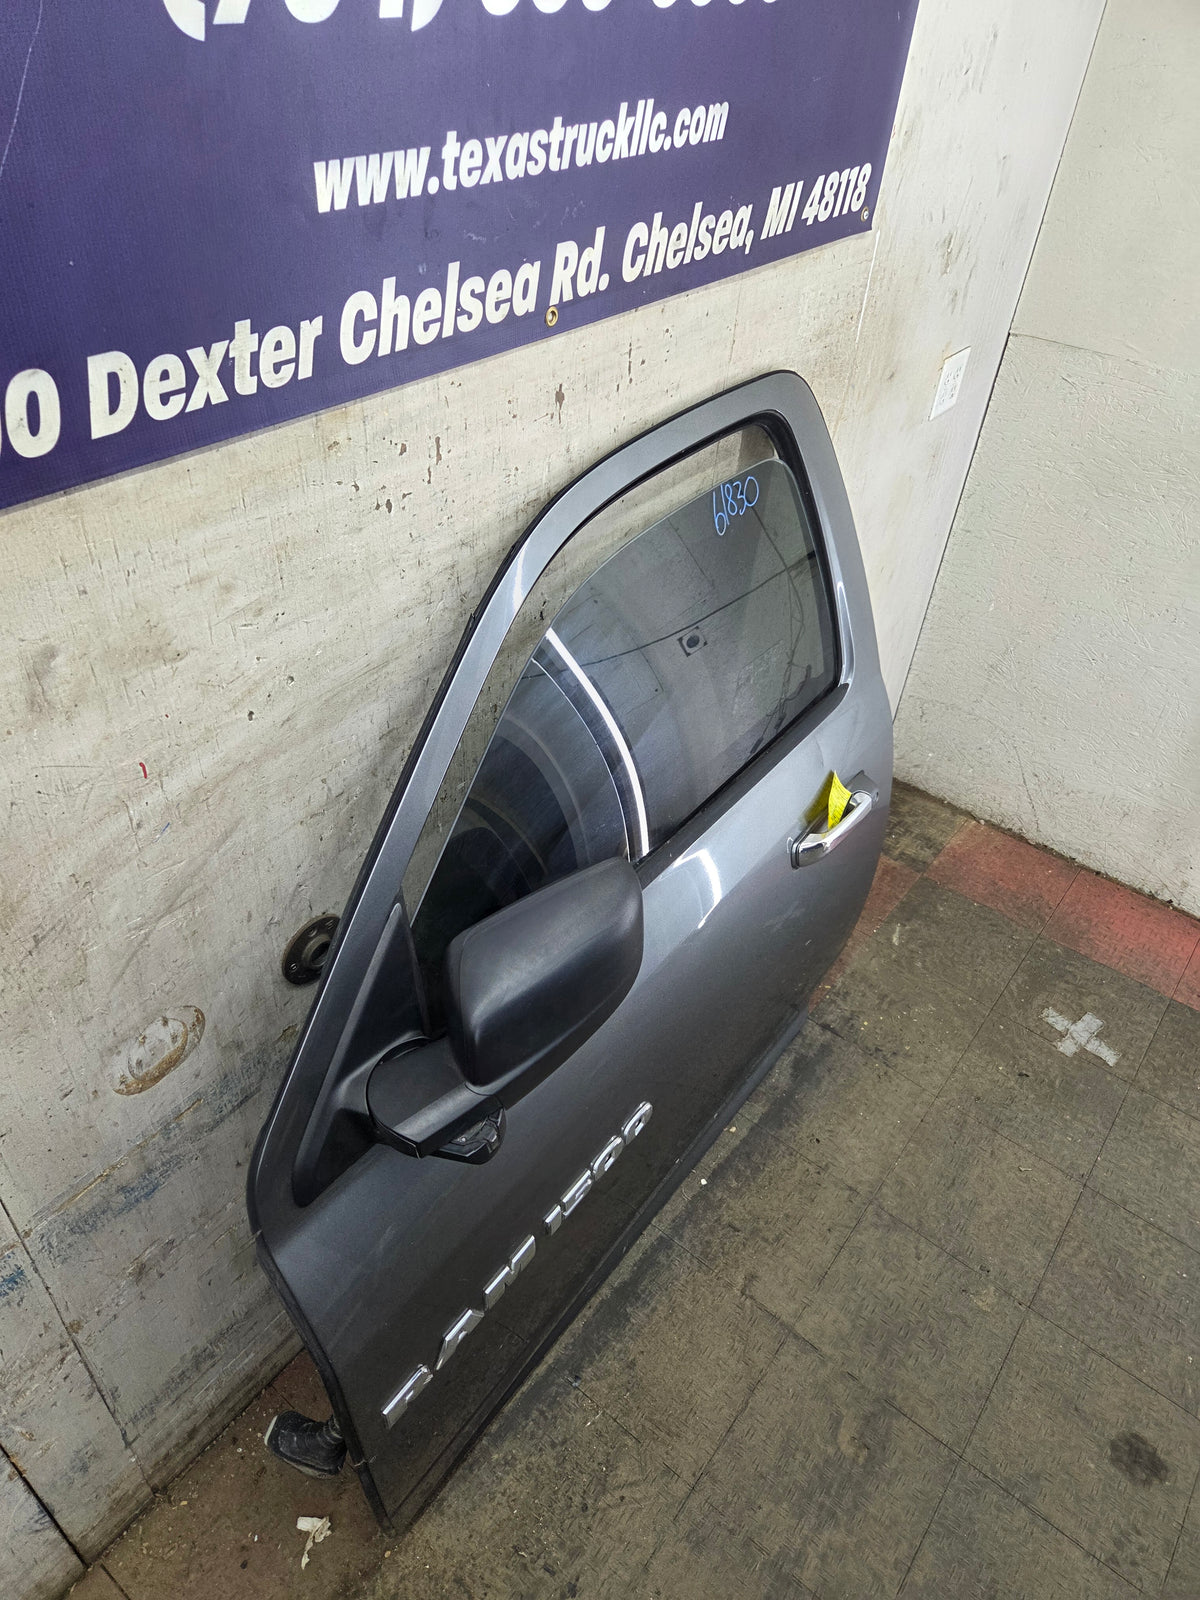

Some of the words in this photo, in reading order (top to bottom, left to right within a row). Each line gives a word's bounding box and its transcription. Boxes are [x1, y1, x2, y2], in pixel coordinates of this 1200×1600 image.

[313, 98, 730, 214] www.texastruckllc.com
[0, 368, 61, 459] 0
[86, 317, 323, 440] Dexter
[340, 260, 542, 366] Chelsea
[548, 225, 610, 307] Rd.
[622, 201, 755, 283] Chelsea,
[760, 180, 805, 241] MI
[800, 162, 873, 226] 48118
[712, 475, 760, 536] 61830
[380, 1234, 537, 1431] RAM
[541, 1100, 654, 1237] 1500
